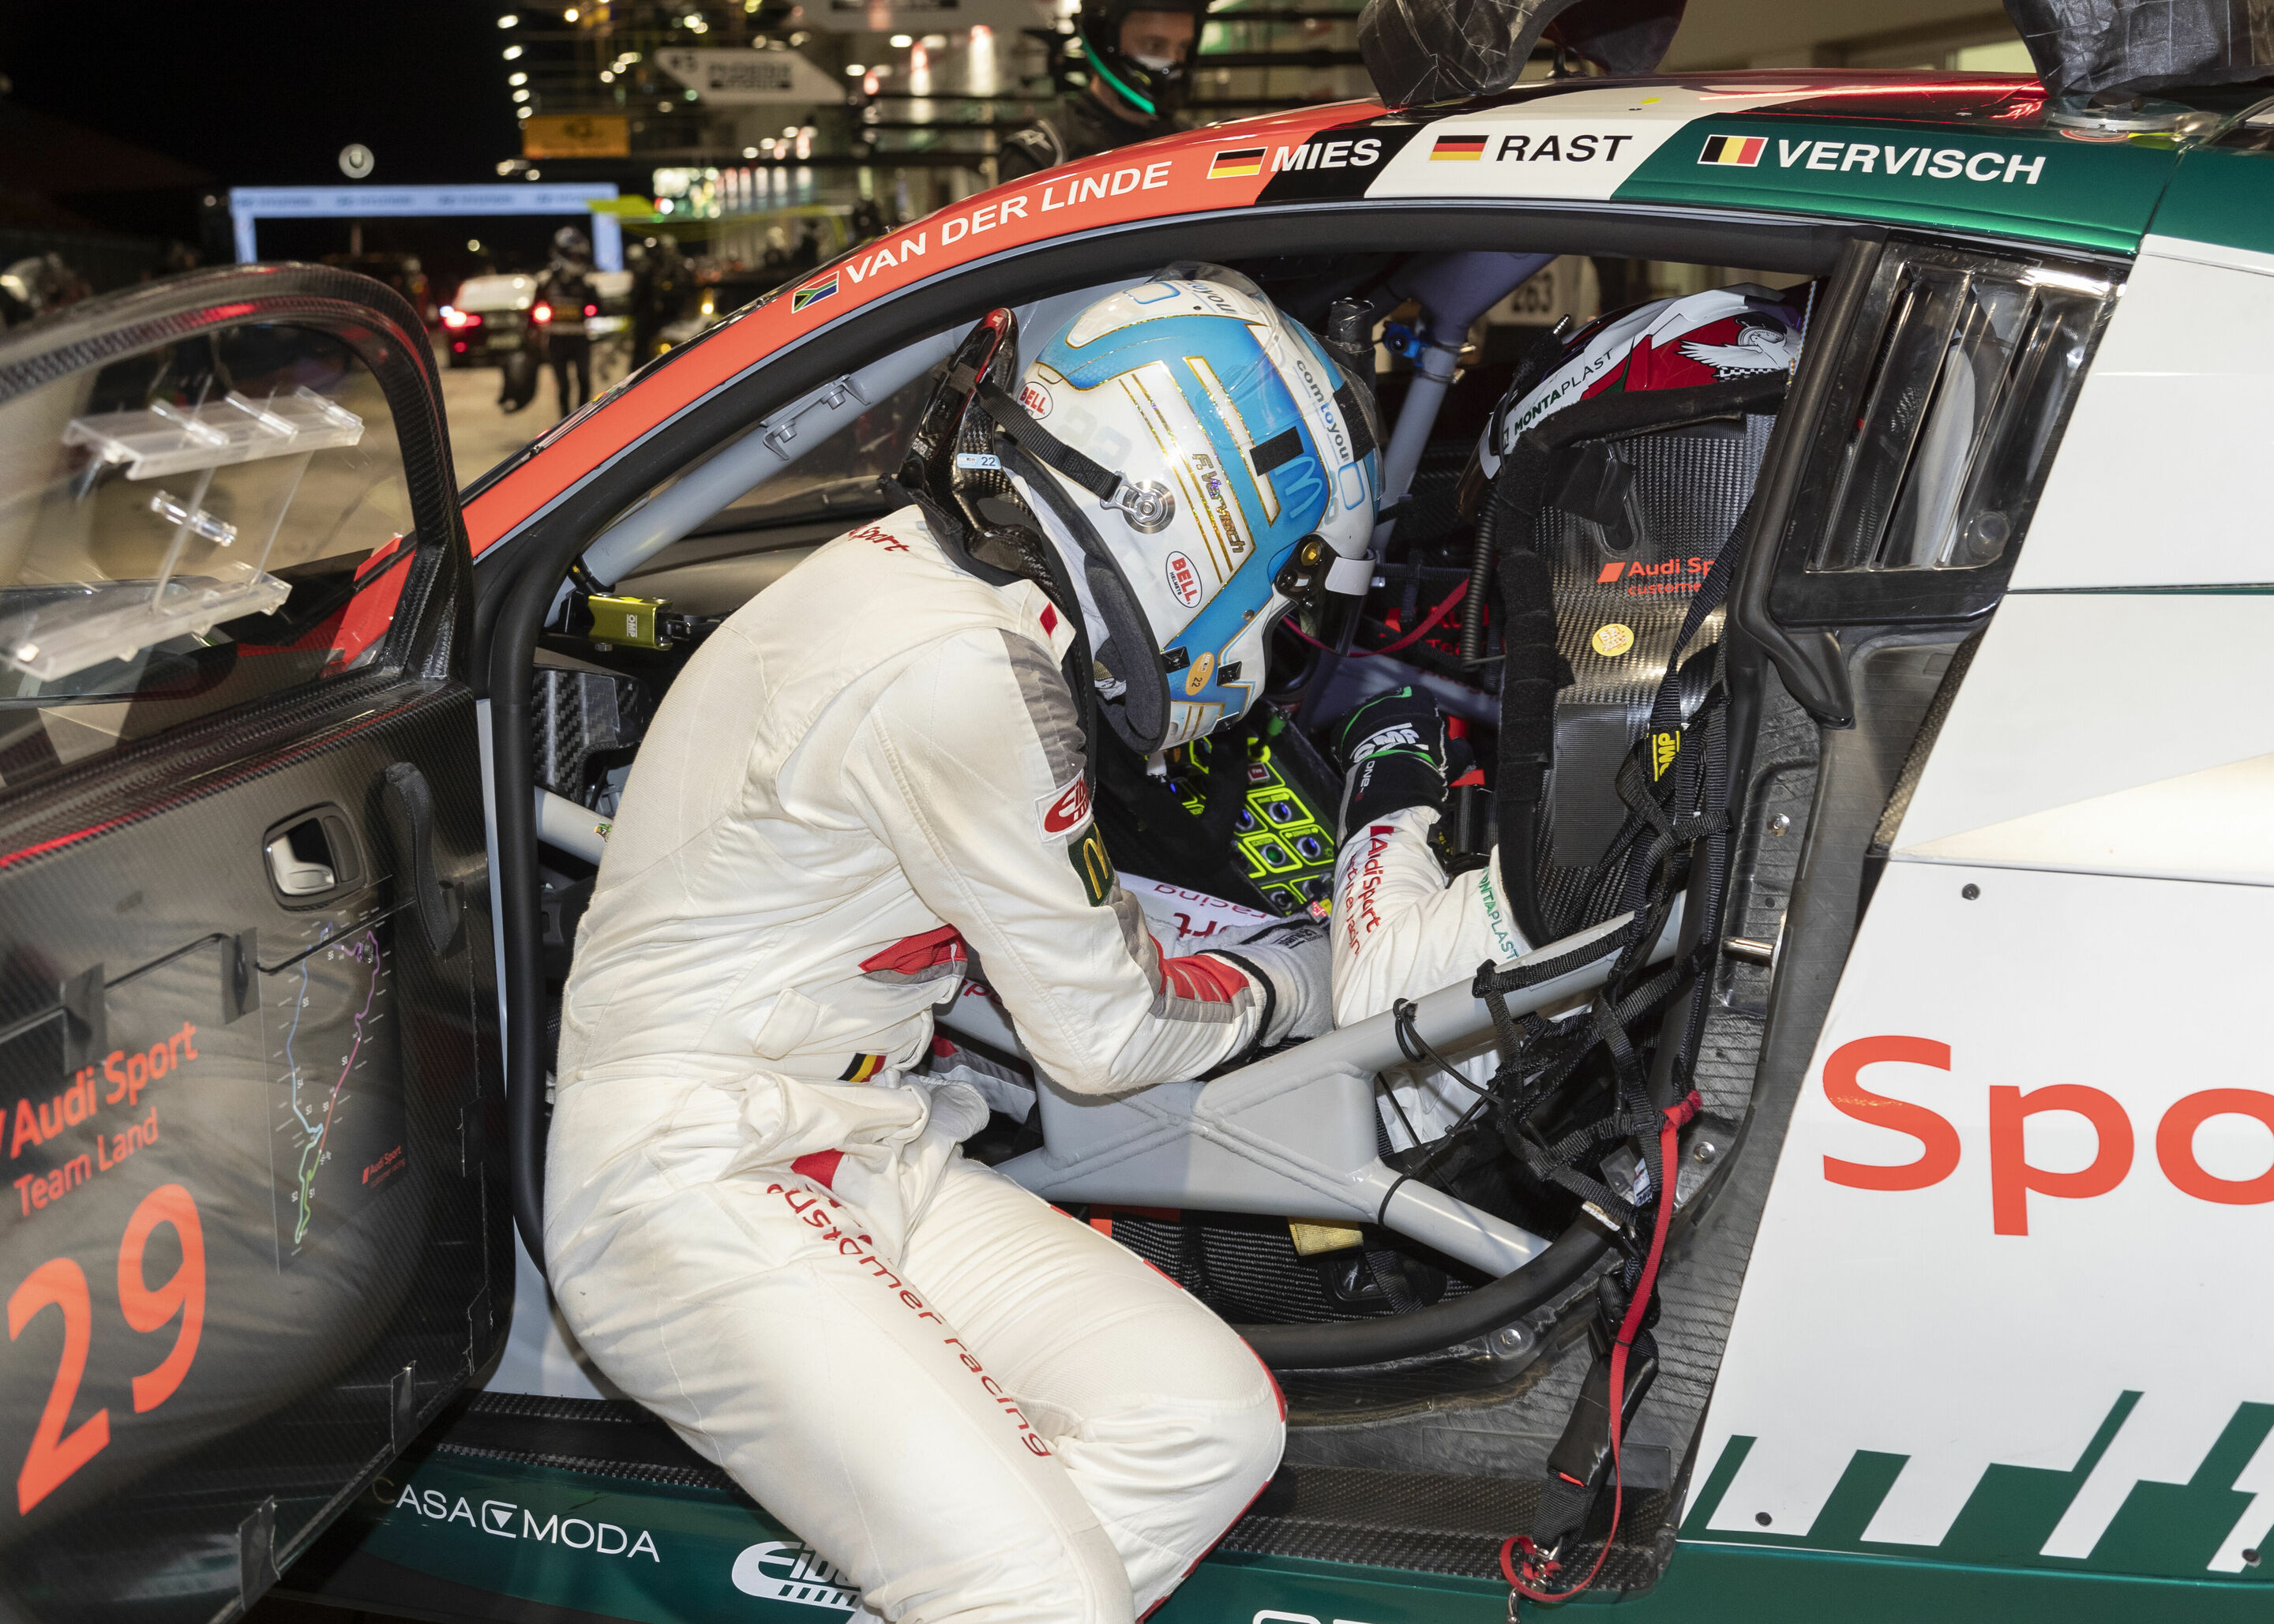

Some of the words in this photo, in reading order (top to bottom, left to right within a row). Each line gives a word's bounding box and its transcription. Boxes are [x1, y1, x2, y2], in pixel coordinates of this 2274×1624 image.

[1270, 139, 1382, 173] MIES
[1496, 134, 1633, 163] RAST
[1778, 139, 2046, 185] VERVISCH
[846, 231, 927, 283] VAN
[941, 195, 1029, 246] DER
[1041, 160, 1171, 212] LINDE
[1514, 347, 1613, 435] MONTAPLAST
[981, 456, 996, 467] 22
[1172, 557, 1199, 606] BELL
[1627, 557, 1681, 577] Audi
[1627, 582, 1702, 595] custome
[628, 613, 638, 638] OMP
[1191, 677, 1203, 688] 22
[10, 1066, 96, 1159] Audi
[104, 1022, 198, 1105] Sport
[13, 1153, 92, 1217] Team
[97, 1106, 159, 1172] Land
[6, 1183, 206, 1517] 29
[944, 1337, 1053, 1457] racing
[523, 1509, 660, 1562] MODA
